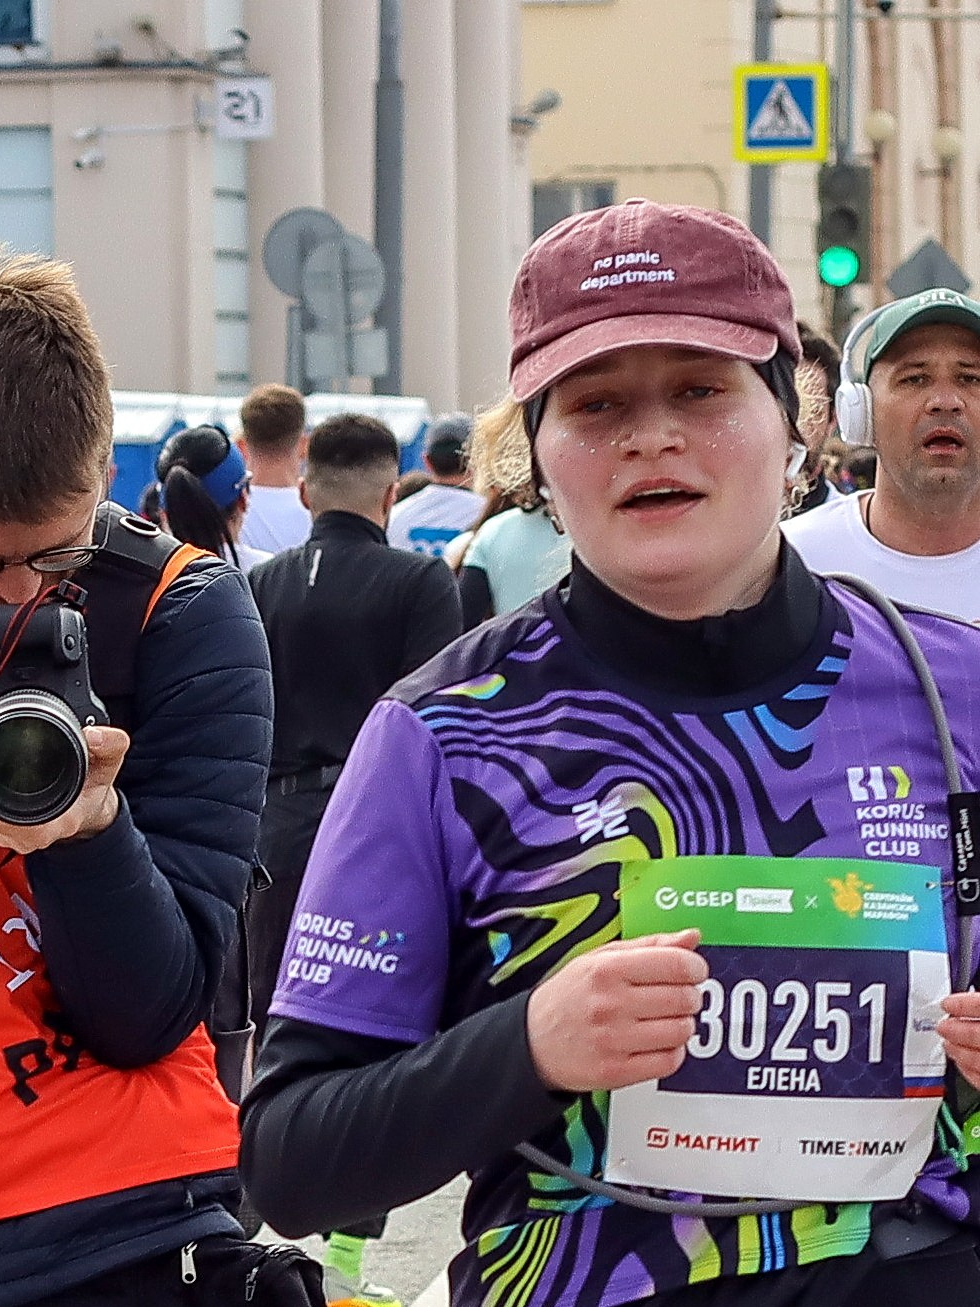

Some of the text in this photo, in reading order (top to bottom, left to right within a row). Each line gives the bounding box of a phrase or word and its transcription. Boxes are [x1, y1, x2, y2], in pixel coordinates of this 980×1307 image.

[593, 250, 660, 271] no panic
[580, 268, 675, 291] department
[856, 803, 925, 820] KORUS
[860, 822, 948, 839] RUNNING
[865, 840, 921, 857] CLUB
[682, 890, 734, 907] СБЕР
[297, 912, 355, 941] ORUS
[296, 936, 399, 975] RUNNING
[687, 978, 887, 1064] 30251
[747, 1066, 821, 1092] ЕЛЕНА
[674, 1133, 761, 1153] МАГНИТ
